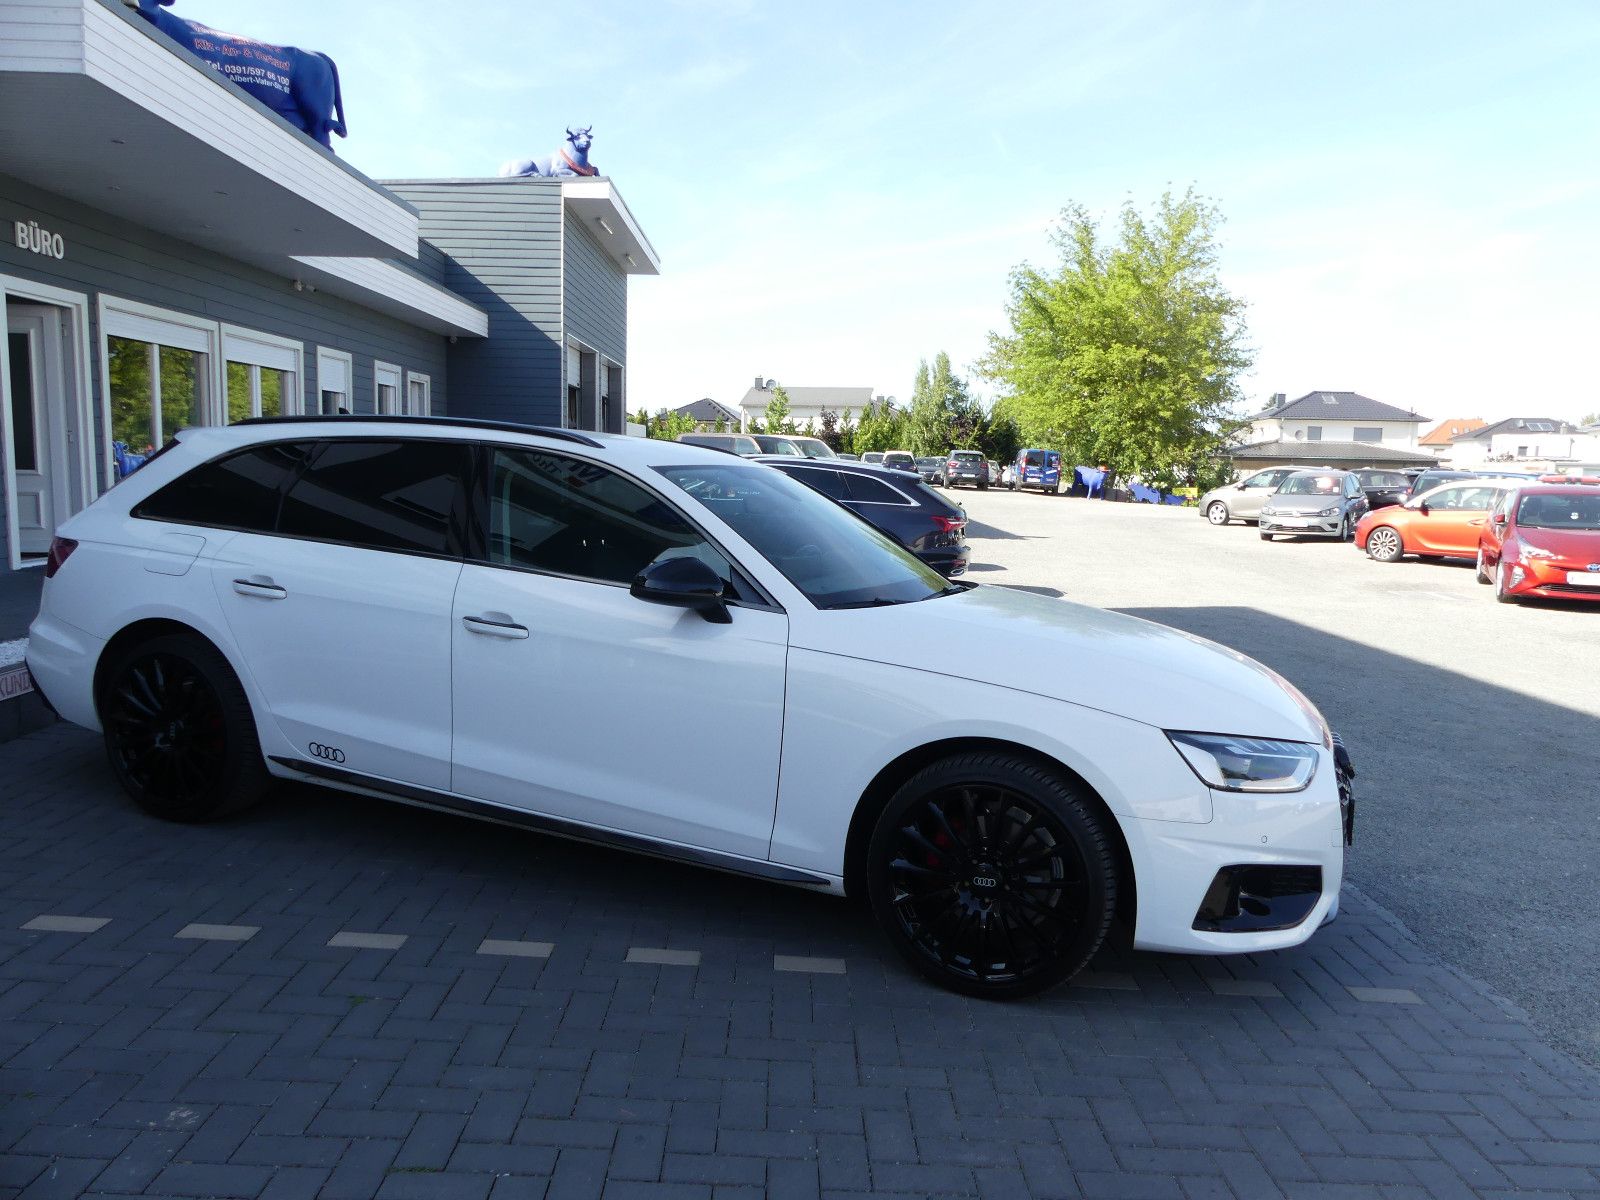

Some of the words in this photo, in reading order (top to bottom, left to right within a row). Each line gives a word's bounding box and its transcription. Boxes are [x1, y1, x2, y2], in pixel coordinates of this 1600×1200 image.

[224, 65, 266, 77] 0391/597
[277, 75, 290, 86] 100
[14, 220, 64, 260] BÜRO
